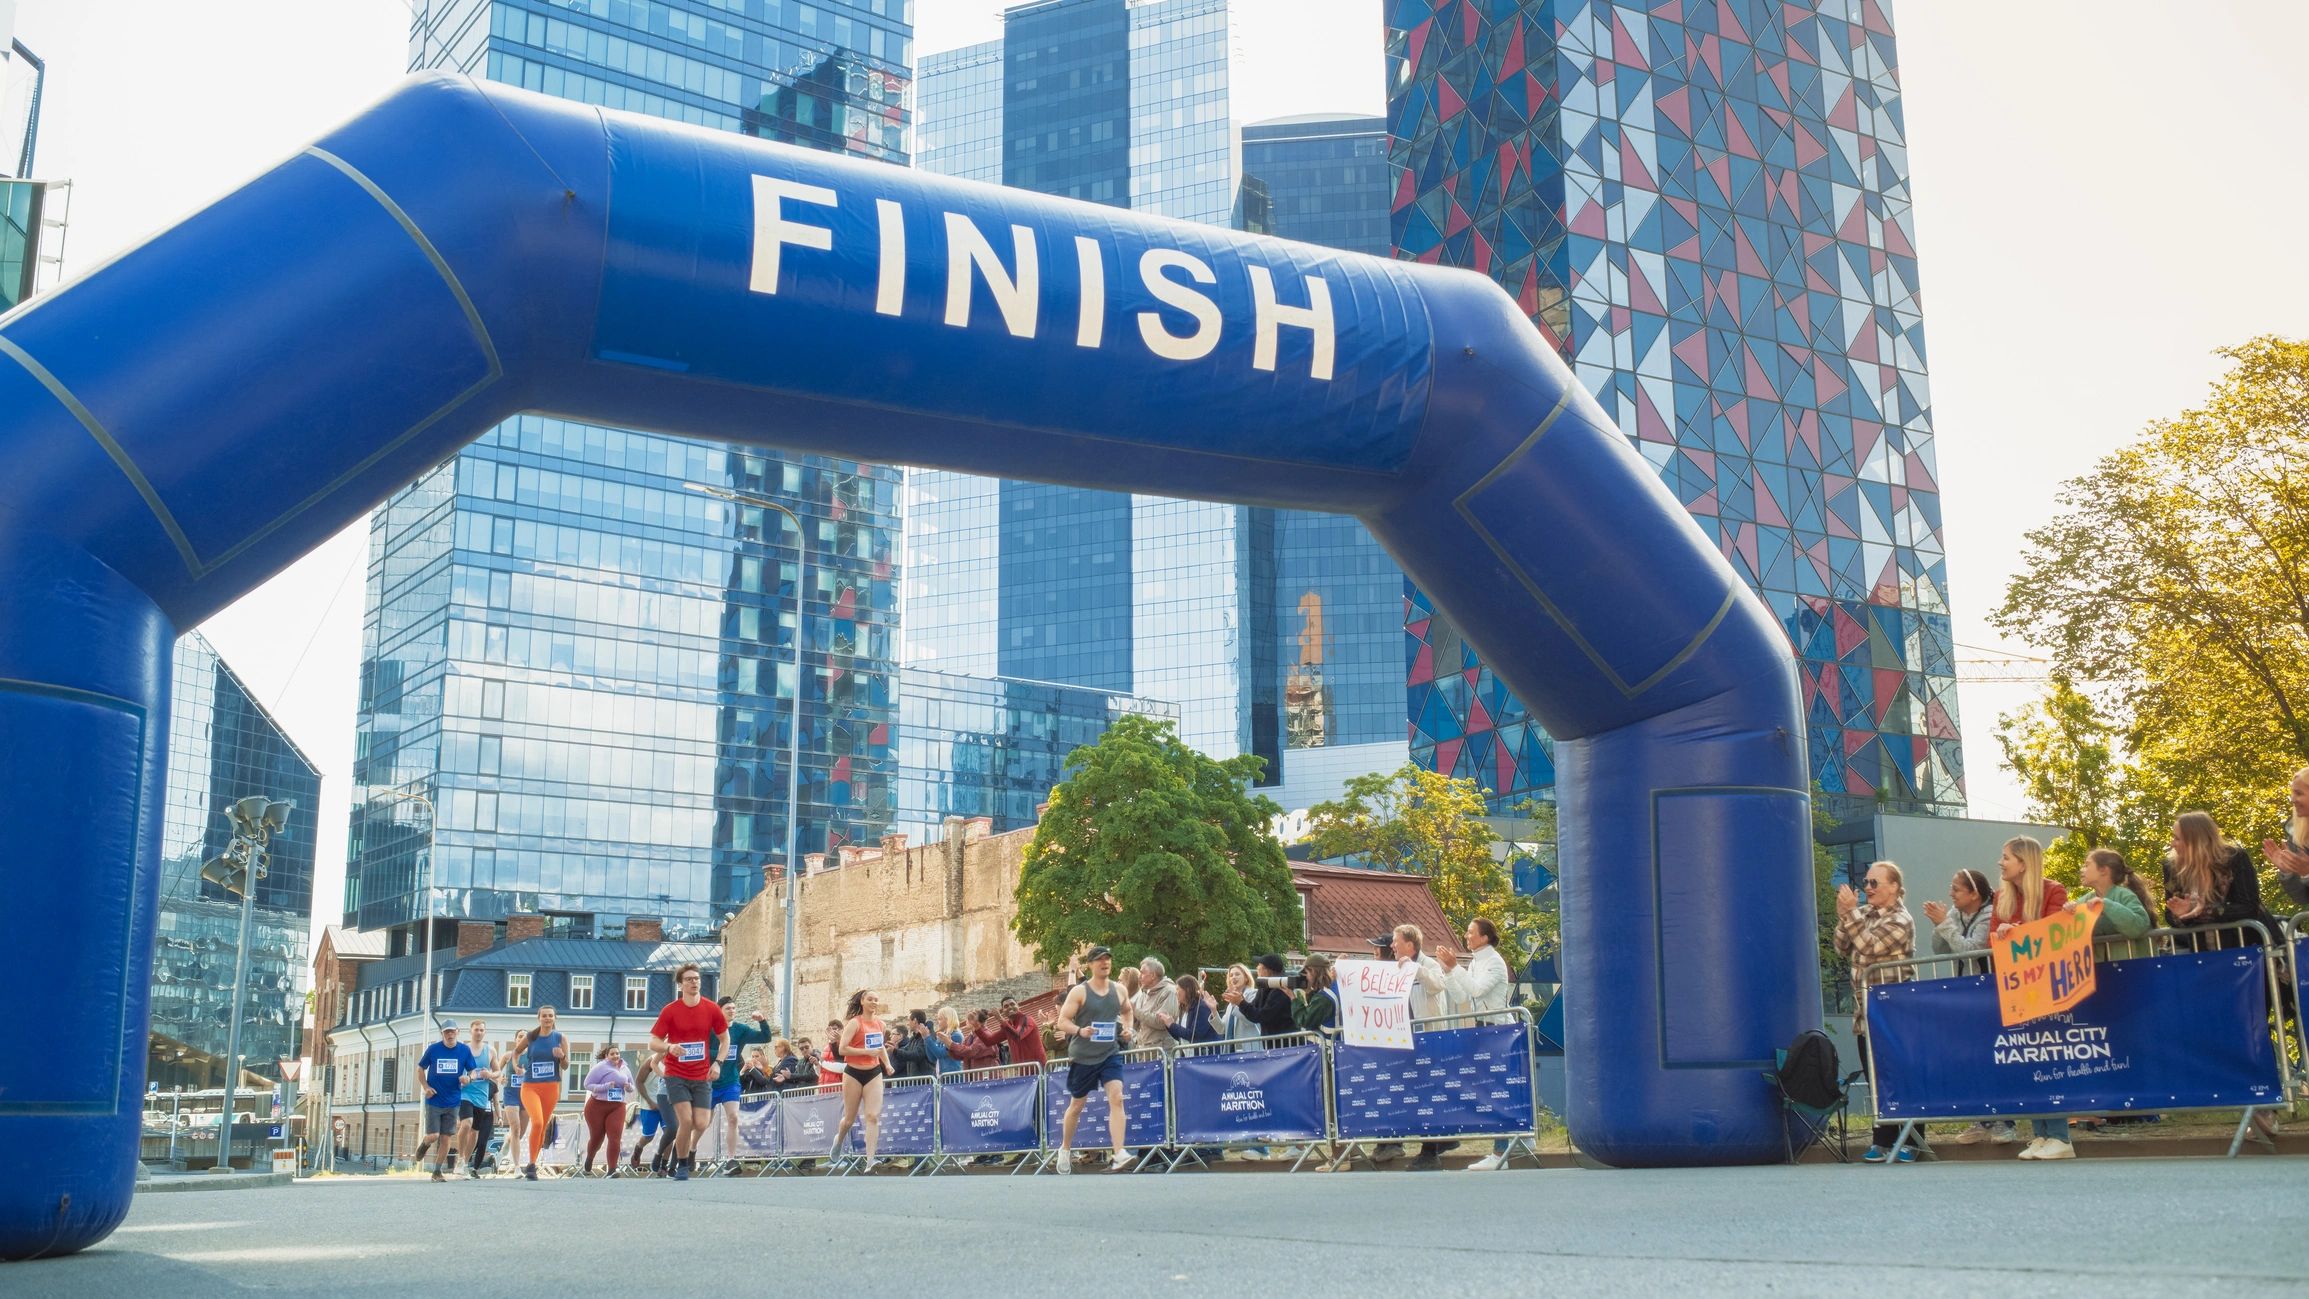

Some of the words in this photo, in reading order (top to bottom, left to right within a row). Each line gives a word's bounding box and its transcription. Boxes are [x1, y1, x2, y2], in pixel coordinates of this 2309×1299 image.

[749, 174, 1335, 380] FINISH
[2048, 912, 2086, 951] DAD
[2049, 944, 2092, 1001] HERO
[1994, 1030, 2063, 1048] ANNUAL
[2065, 1027, 2108, 1043] CITY
[1994, 1042, 2112, 1065] MARATHON
[2066, 1063, 2092, 1078] health
[1221, 1100, 1265, 1111] MARATHON
[1247, 1090, 1264, 1099] CITY
